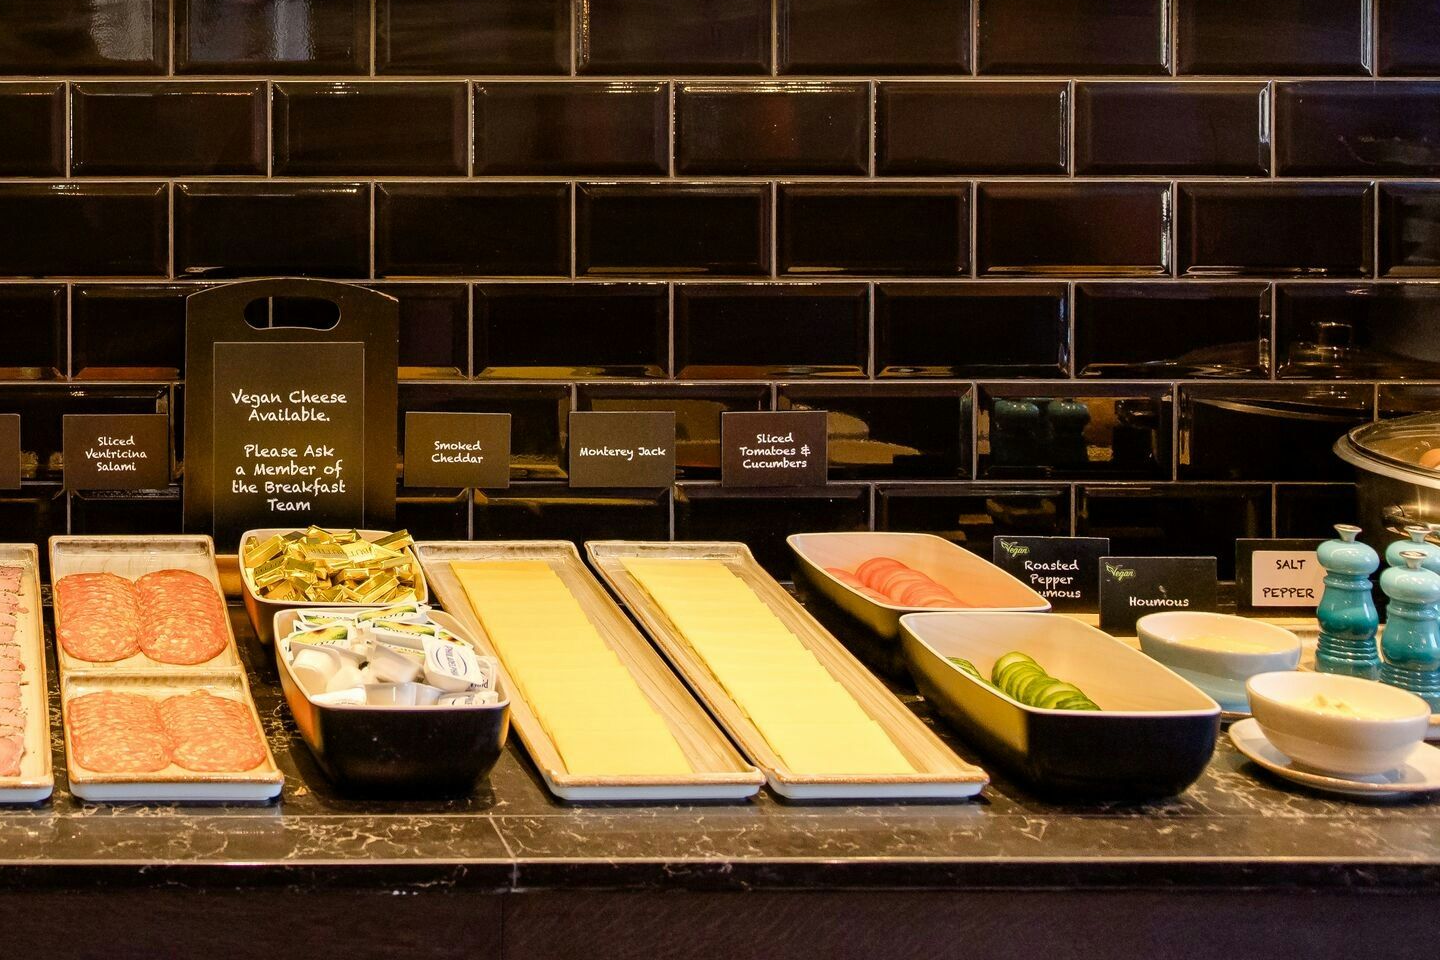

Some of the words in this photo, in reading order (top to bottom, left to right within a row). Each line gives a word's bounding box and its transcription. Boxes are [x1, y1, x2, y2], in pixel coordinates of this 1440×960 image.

[231, 388, 282, 408] Vegan
[288, 390, 348, 404] Cheese
[248, 408, 330, 422] Available.
[97, 435, 136, 447] Sliced
[756, 432, 795, 445] Sliced
[244, 444, 298, 458] Please
[303, 444, 335, 457] Ask
[433, 440, 482, 452] Smoked
[739, 445, 797, 457] Tomatoes
[800, 445, 811, 457] &
[85, 449, 148, 459] Ventricina
[431, 453, 484, 464] Cheddar
[579, 446, 634, 461] Monterey
[637, 446, 666, 458] Jack
[96, 461, 137, 472] Salami
[235, 466, 246, 476] a
[254, 460, 316, 476] Member
[323, 459, 343, 479] of
[742, 457, 807, 470] Cucumbers
[232, 480, 259, 494] the
[264, 478, 346, 497] Breakfast
[267, 498, 311, 512] Team
[1001, 539, 1030, 557] Vegan
[1024, 559, 1080, 571] Roasted
[1105, 562, 1135, 581] Vegan
[1275, 559, 1307, 571] SALT
[1030, 573, 1074, 590] Pepper
[1038, 590, 1081, 598] umous
[1262, 587, 1315, 600] PEPPER
[1129, 596, 1190, 608] Houmous
